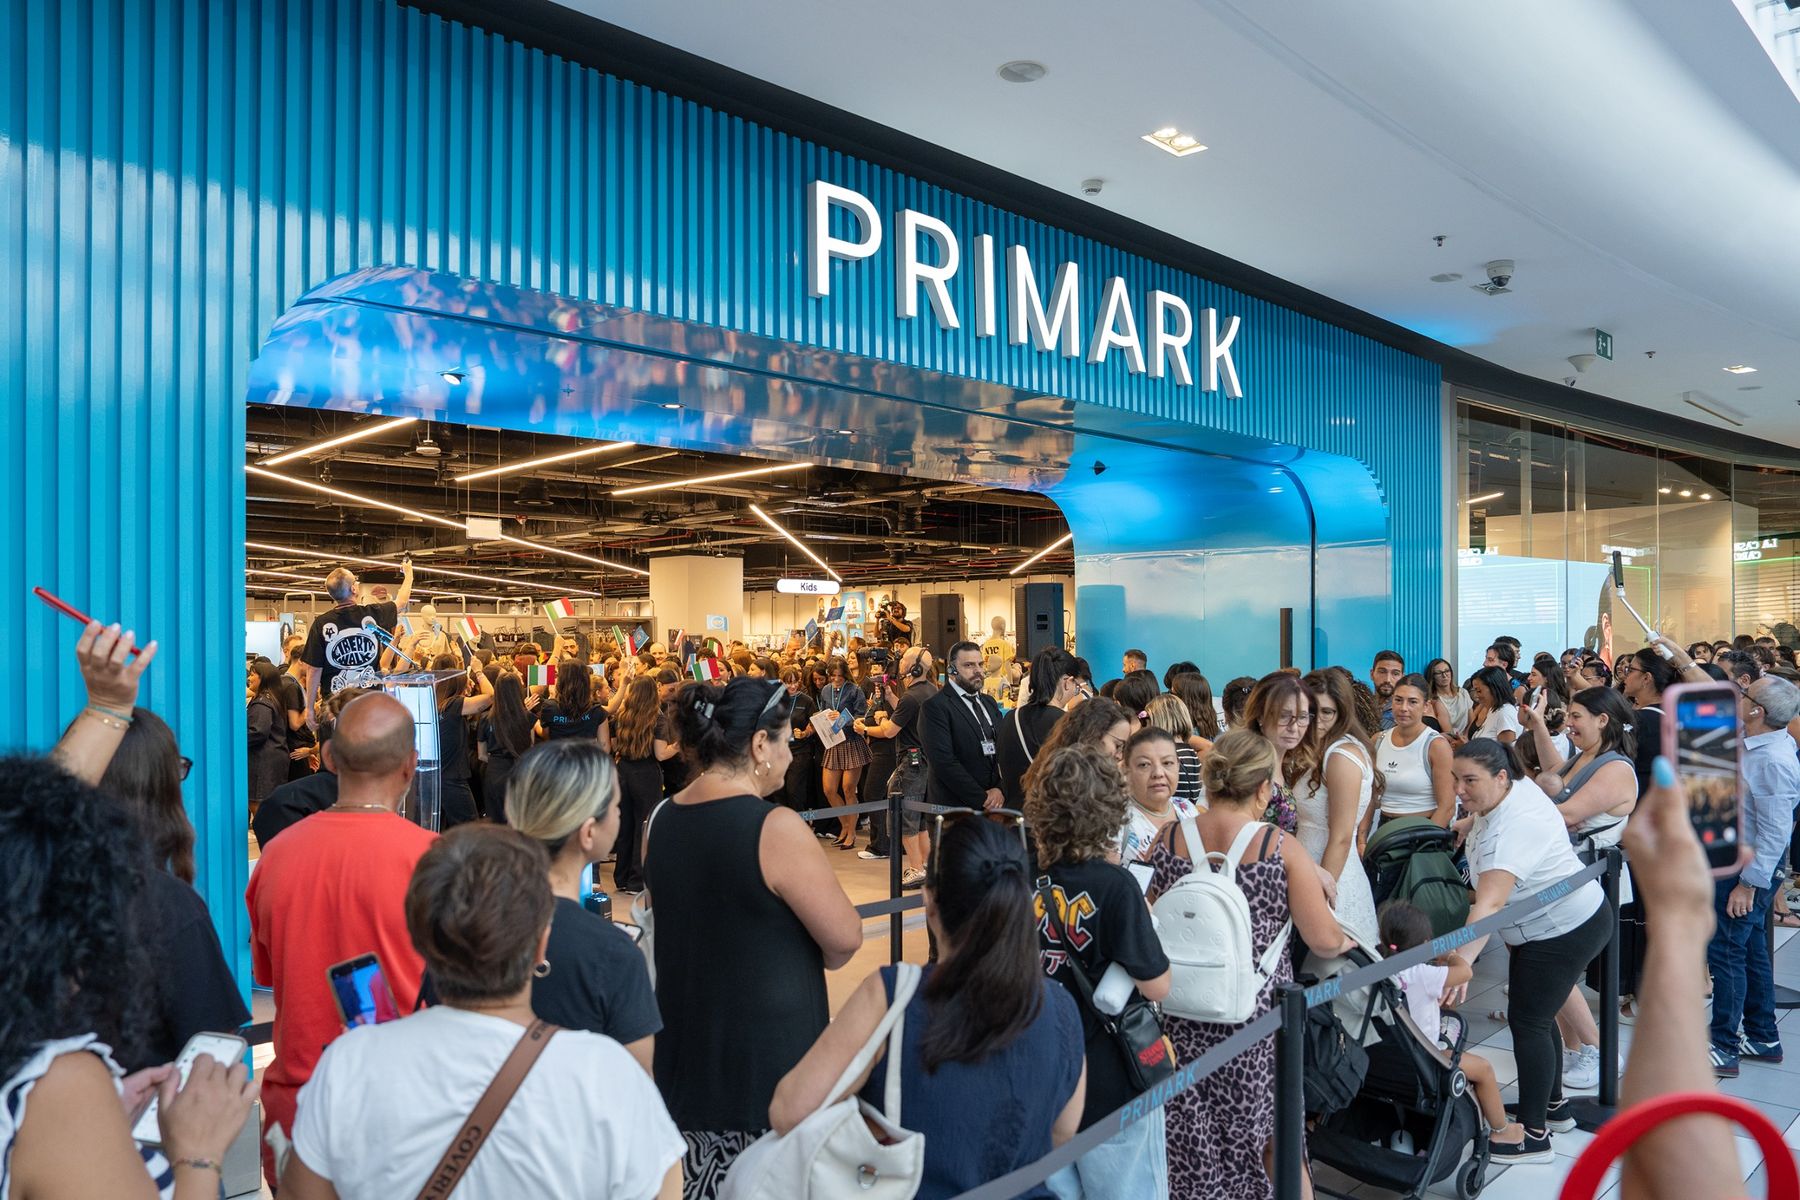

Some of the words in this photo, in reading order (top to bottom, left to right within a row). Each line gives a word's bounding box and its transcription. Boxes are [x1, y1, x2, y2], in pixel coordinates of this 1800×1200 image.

[808, 180, 1243, 399] PRIMARK
[800, 582, 818, 591] Kids
[334, 636, 376, 657] LIBERTY
[339, 651, 371, 665] WALK
[1536, 879, 1572, 905] PRIMARK
[1432, 926, 1477, 955] PRIMARK
[1304, 977, 1342, 1008] MARK
[1120, 1061, 1199, 1129] PRIMARK
